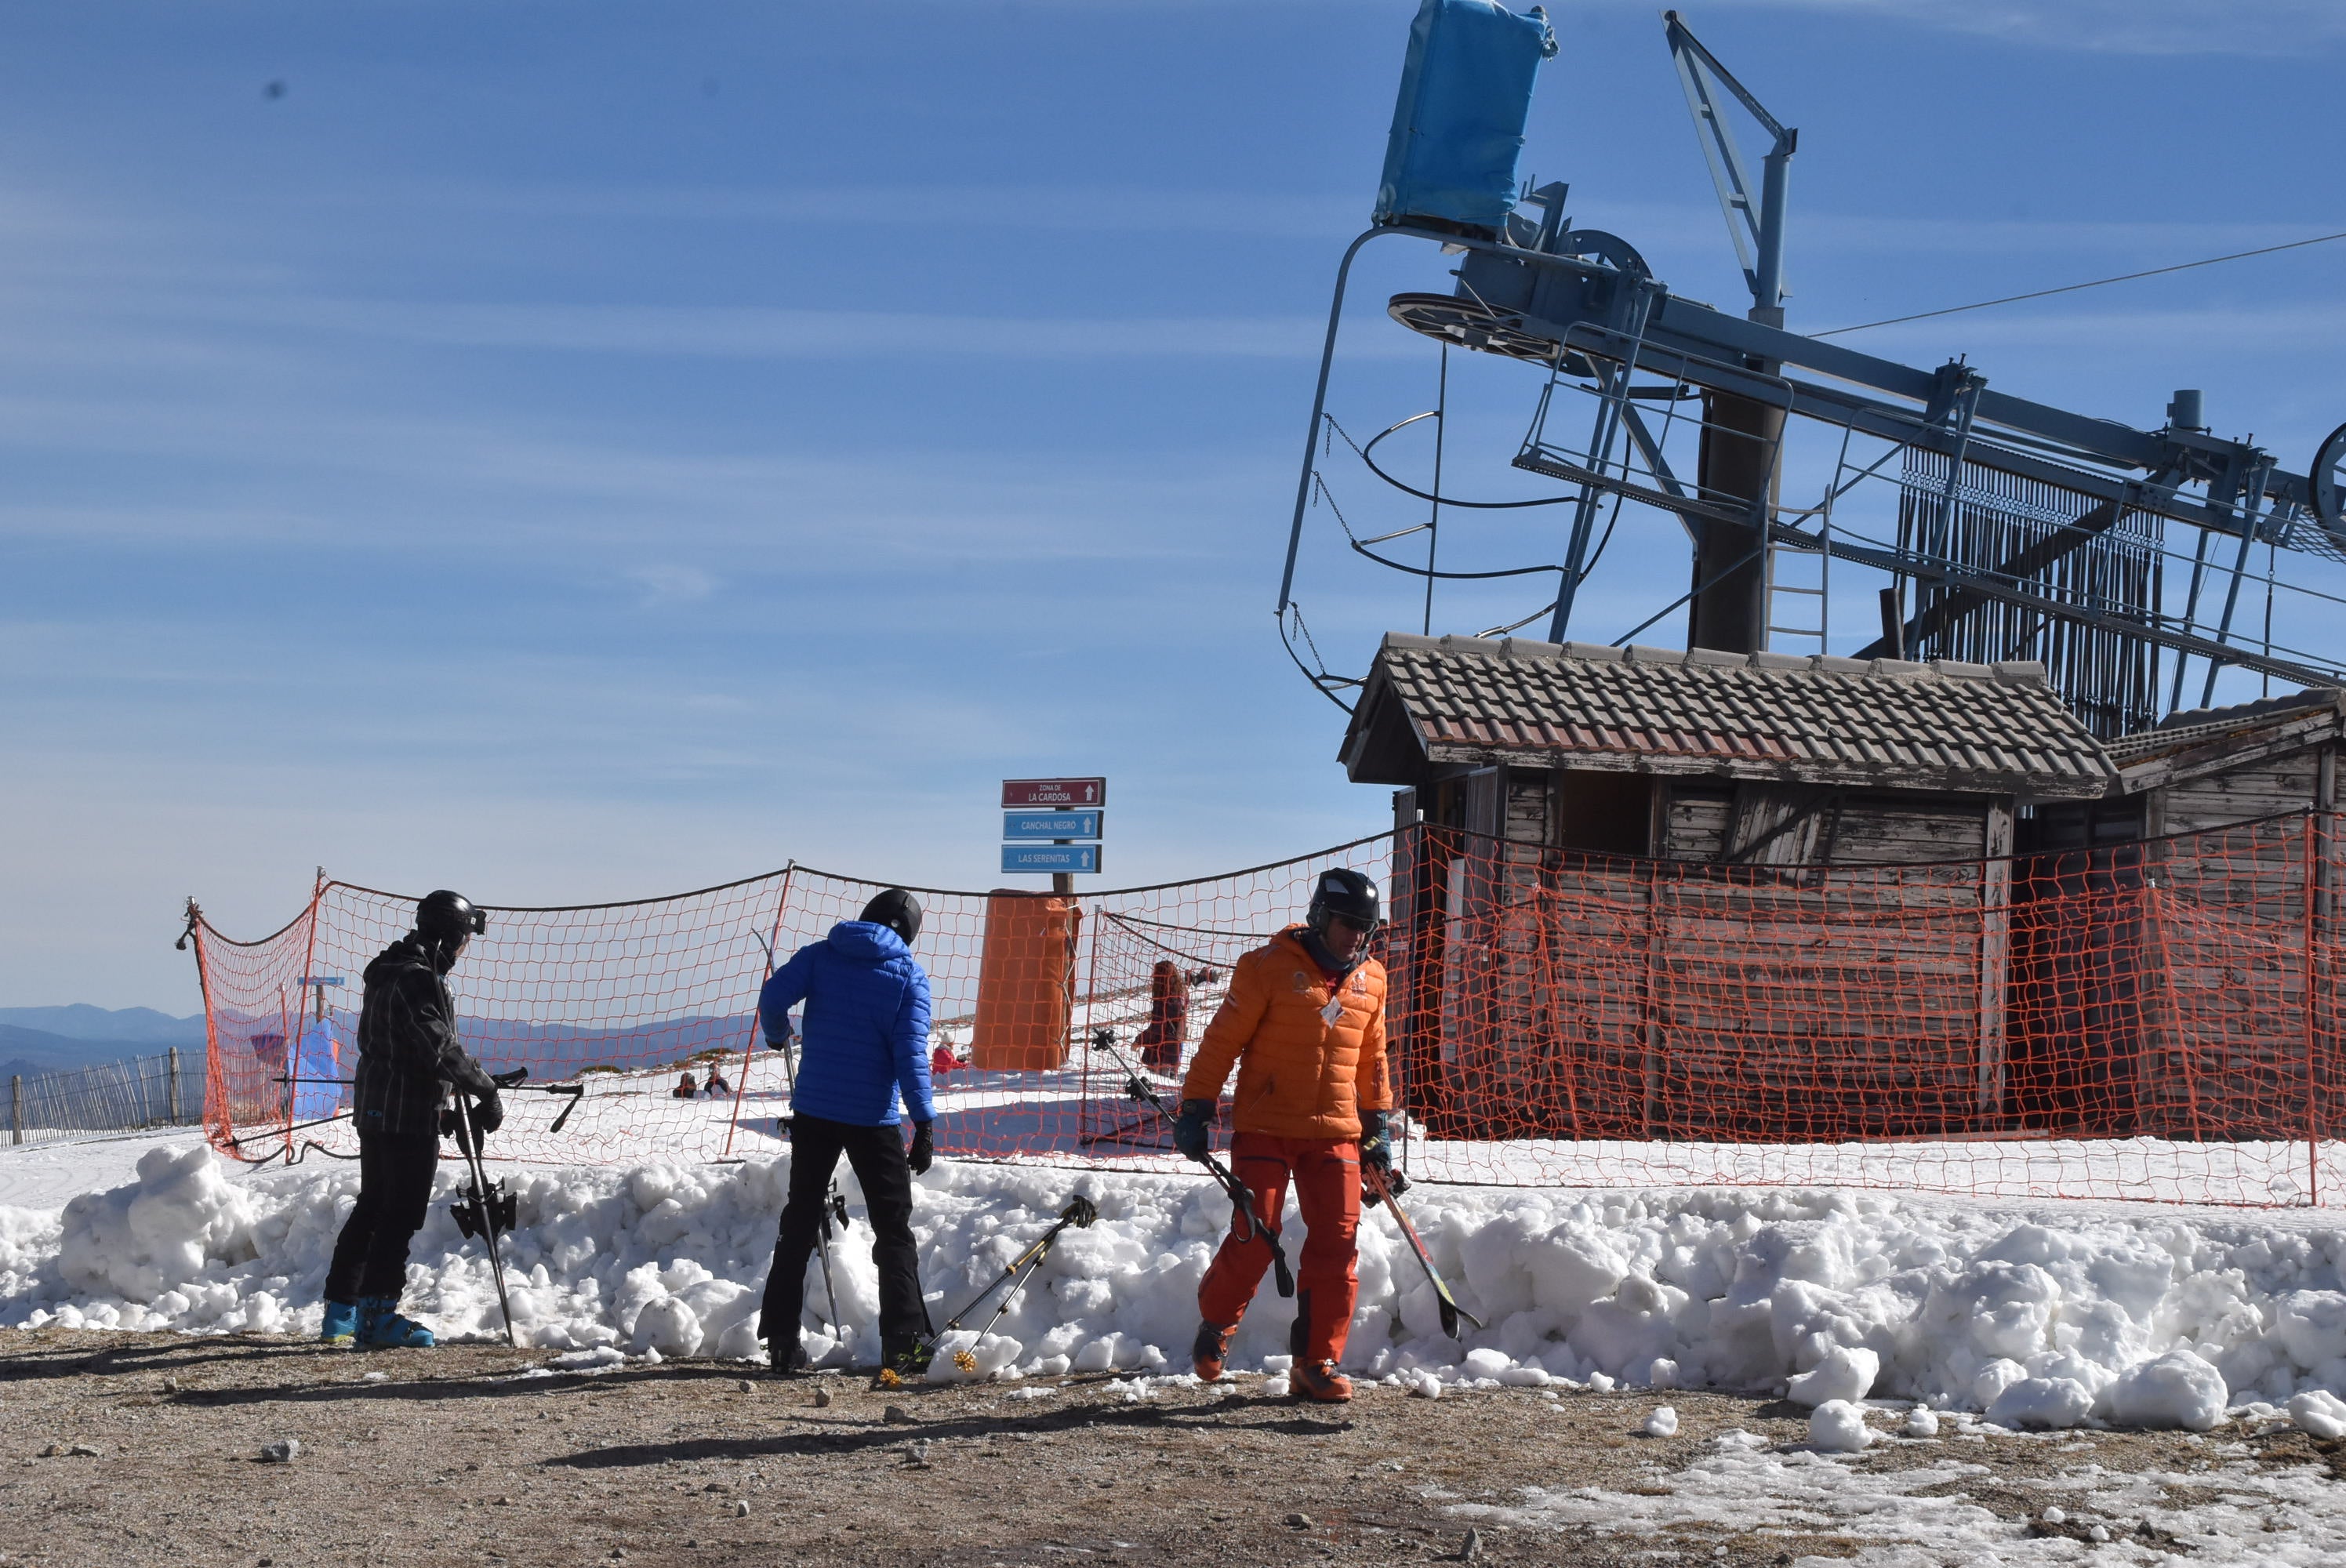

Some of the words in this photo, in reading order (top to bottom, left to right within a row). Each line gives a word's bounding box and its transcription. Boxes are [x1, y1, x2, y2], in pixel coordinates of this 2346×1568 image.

[1029, 793, 1037, 802] LA
[1038, 793, 1071, 802] CARDOSA
[1021, 821, 1052, 830] CANCHAL
[1053, 821, 1077, 829] NEGRO
[1018, 854, 1032, 863] LAS
[1033, 854, 1070, 863] SERENITAS
